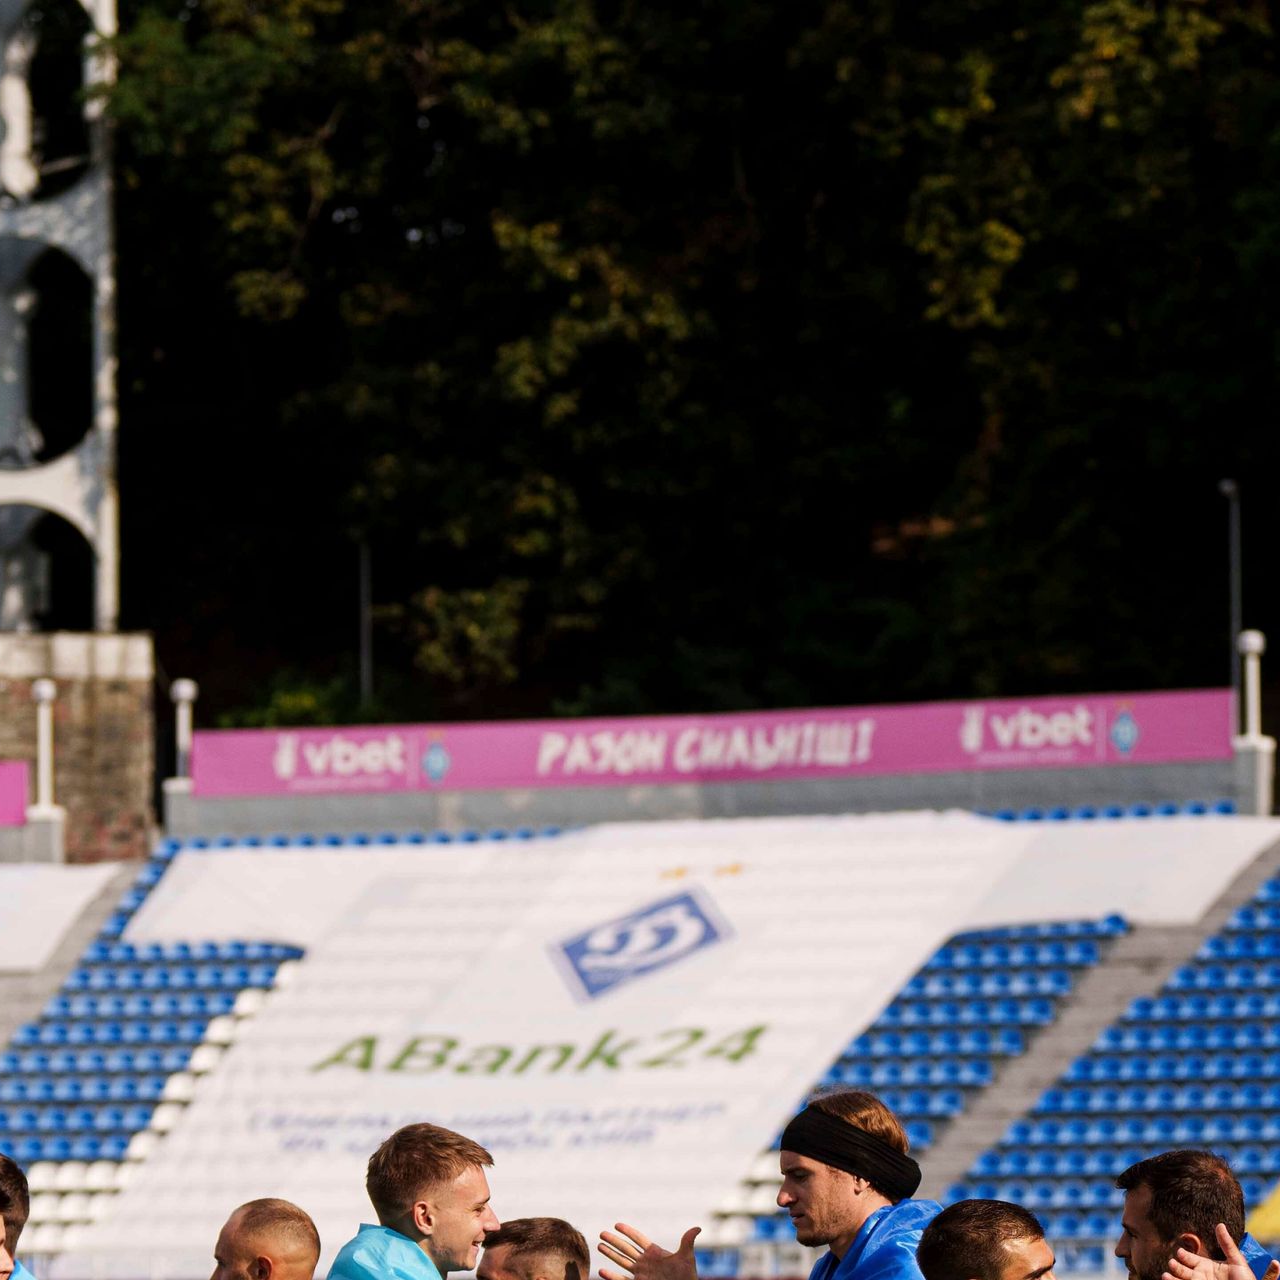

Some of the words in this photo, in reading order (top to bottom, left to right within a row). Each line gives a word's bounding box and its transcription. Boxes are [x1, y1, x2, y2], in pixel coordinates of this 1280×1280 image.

[989, 704, 1093, 748] vbet
[303, 732, 405, 776] vbet
[310, 1022, 769, 1074] ABank24
